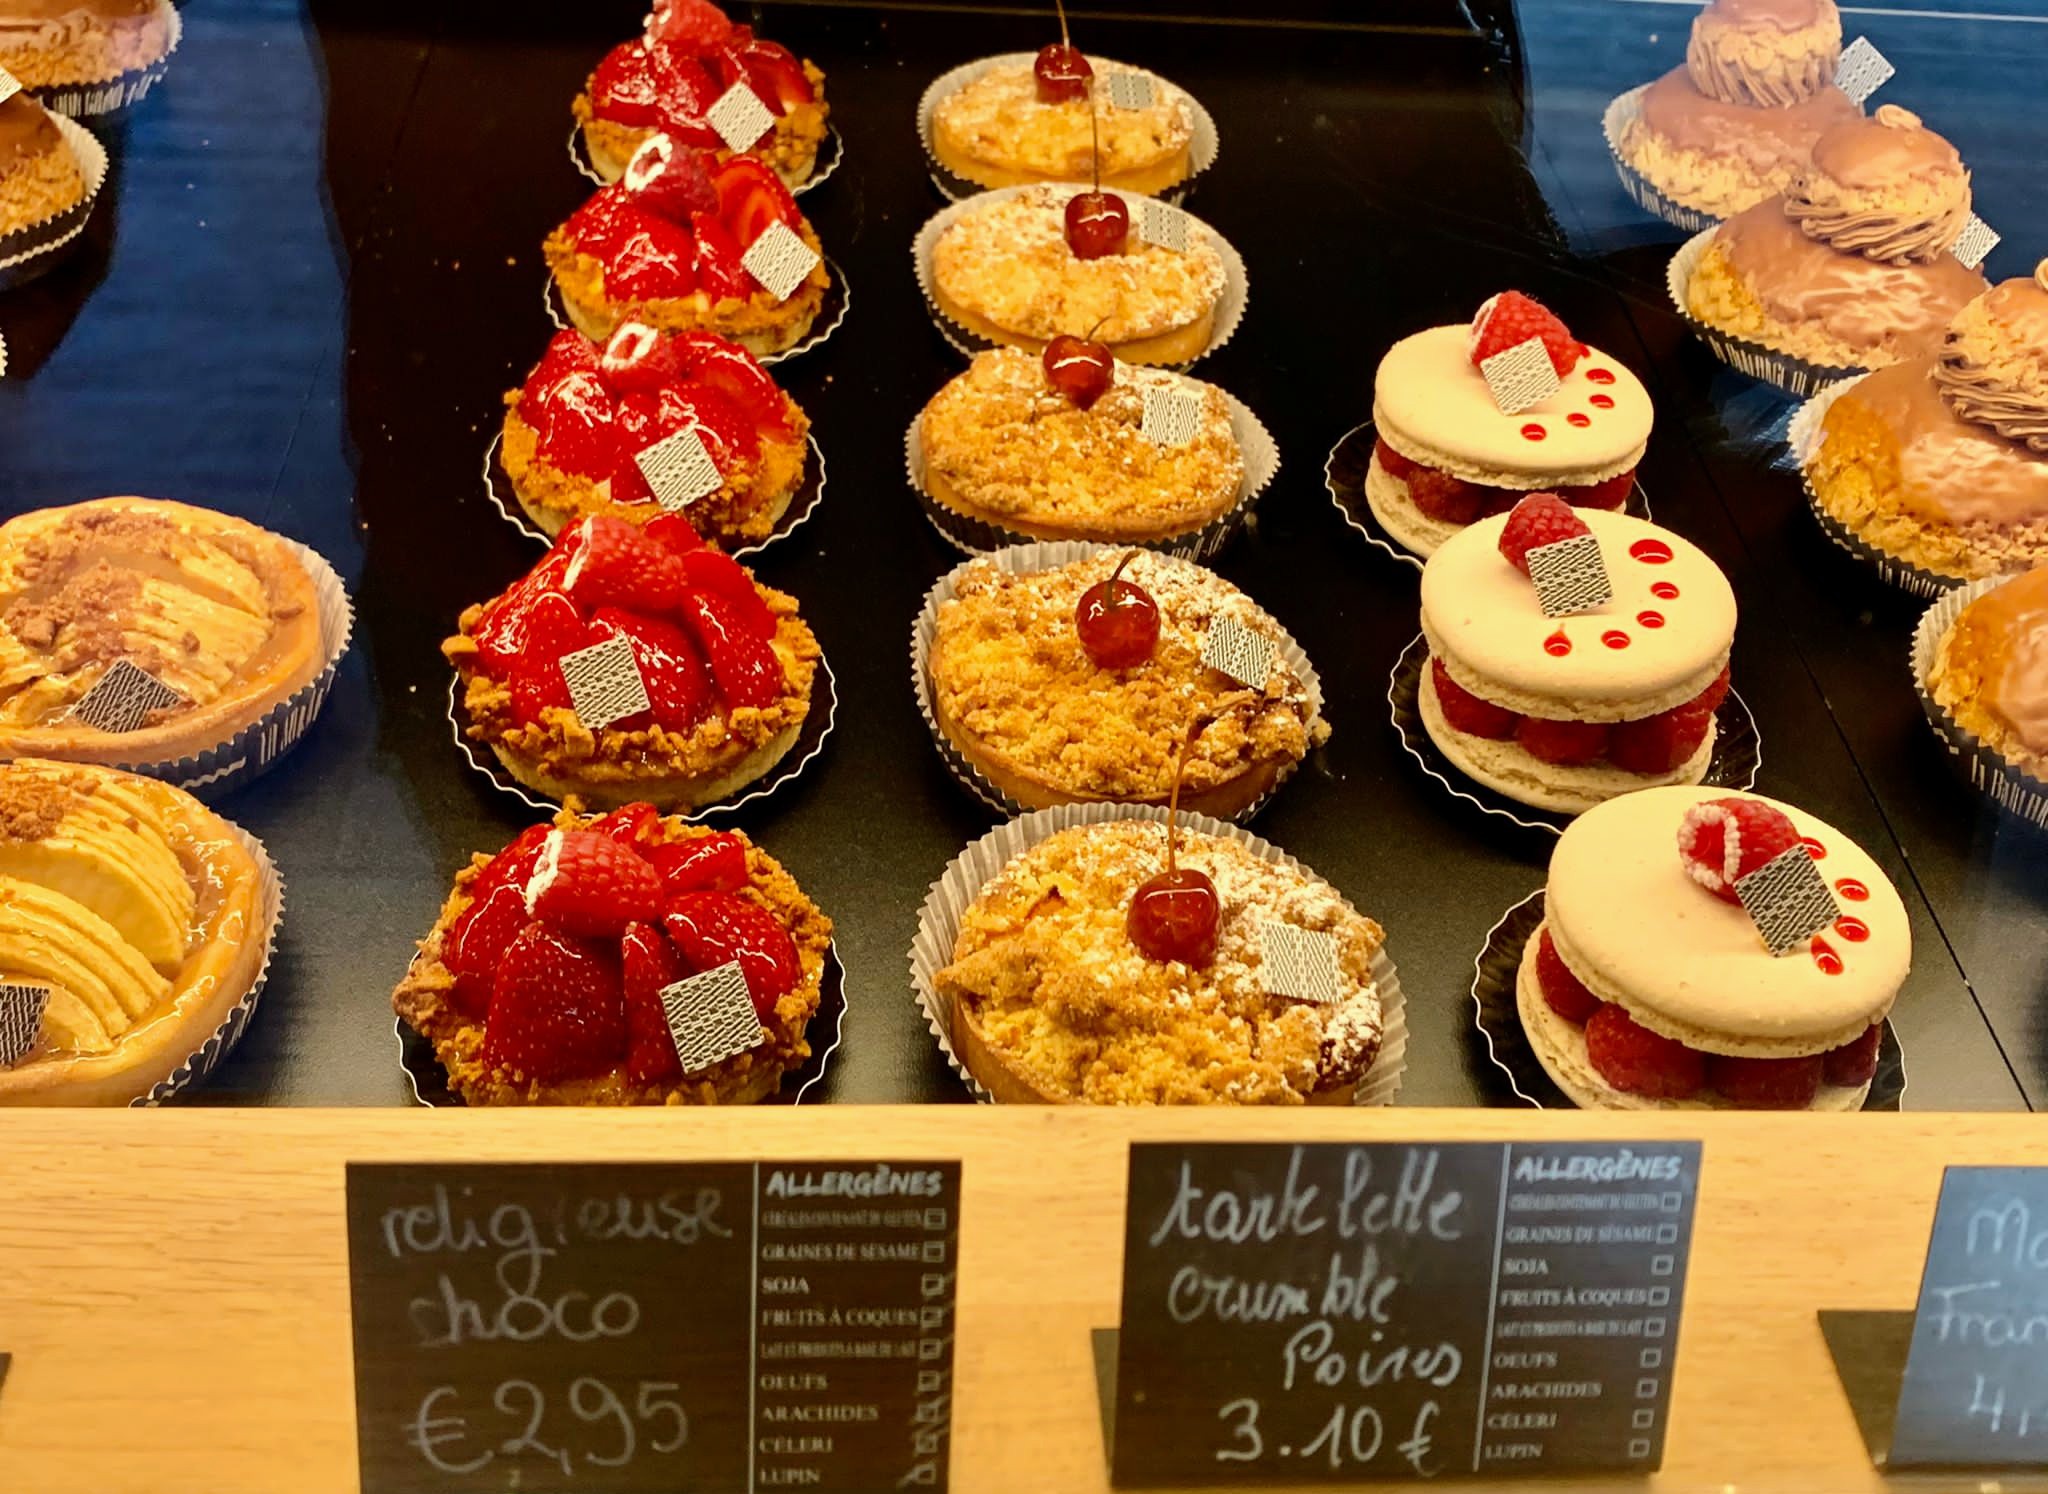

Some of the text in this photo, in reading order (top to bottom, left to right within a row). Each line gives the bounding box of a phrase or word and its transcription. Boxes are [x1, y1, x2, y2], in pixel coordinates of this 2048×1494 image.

[1515, 1149, 1682, 1183] ALLERGÈNES
[766, 1163, 943, 1199] ALLERGÈNES
[1503, 1258, 1549, 1276] SOJA
[762, 1276, 810, 1295] SOJA
[1501, 1289, 1561, 1307] FRUITS
[1579, 1288, 1649, 1308] COQUES
[763, 1308, 825, 1327] FRUITS
[845, 1308, 919, 1328] COQUES
[1493, 1352, 1558, 1369] OEUFS
[760, 1373, 829, 1391] OEUFS
[1492, 1381, 1602, 1399] ARACHIDES
[763, 1404, 879, 1422] ARACHIDES
[1485, 1443, 1544, 1460] LUPIN
[760, 1467, 821, 1485] LUPIN
